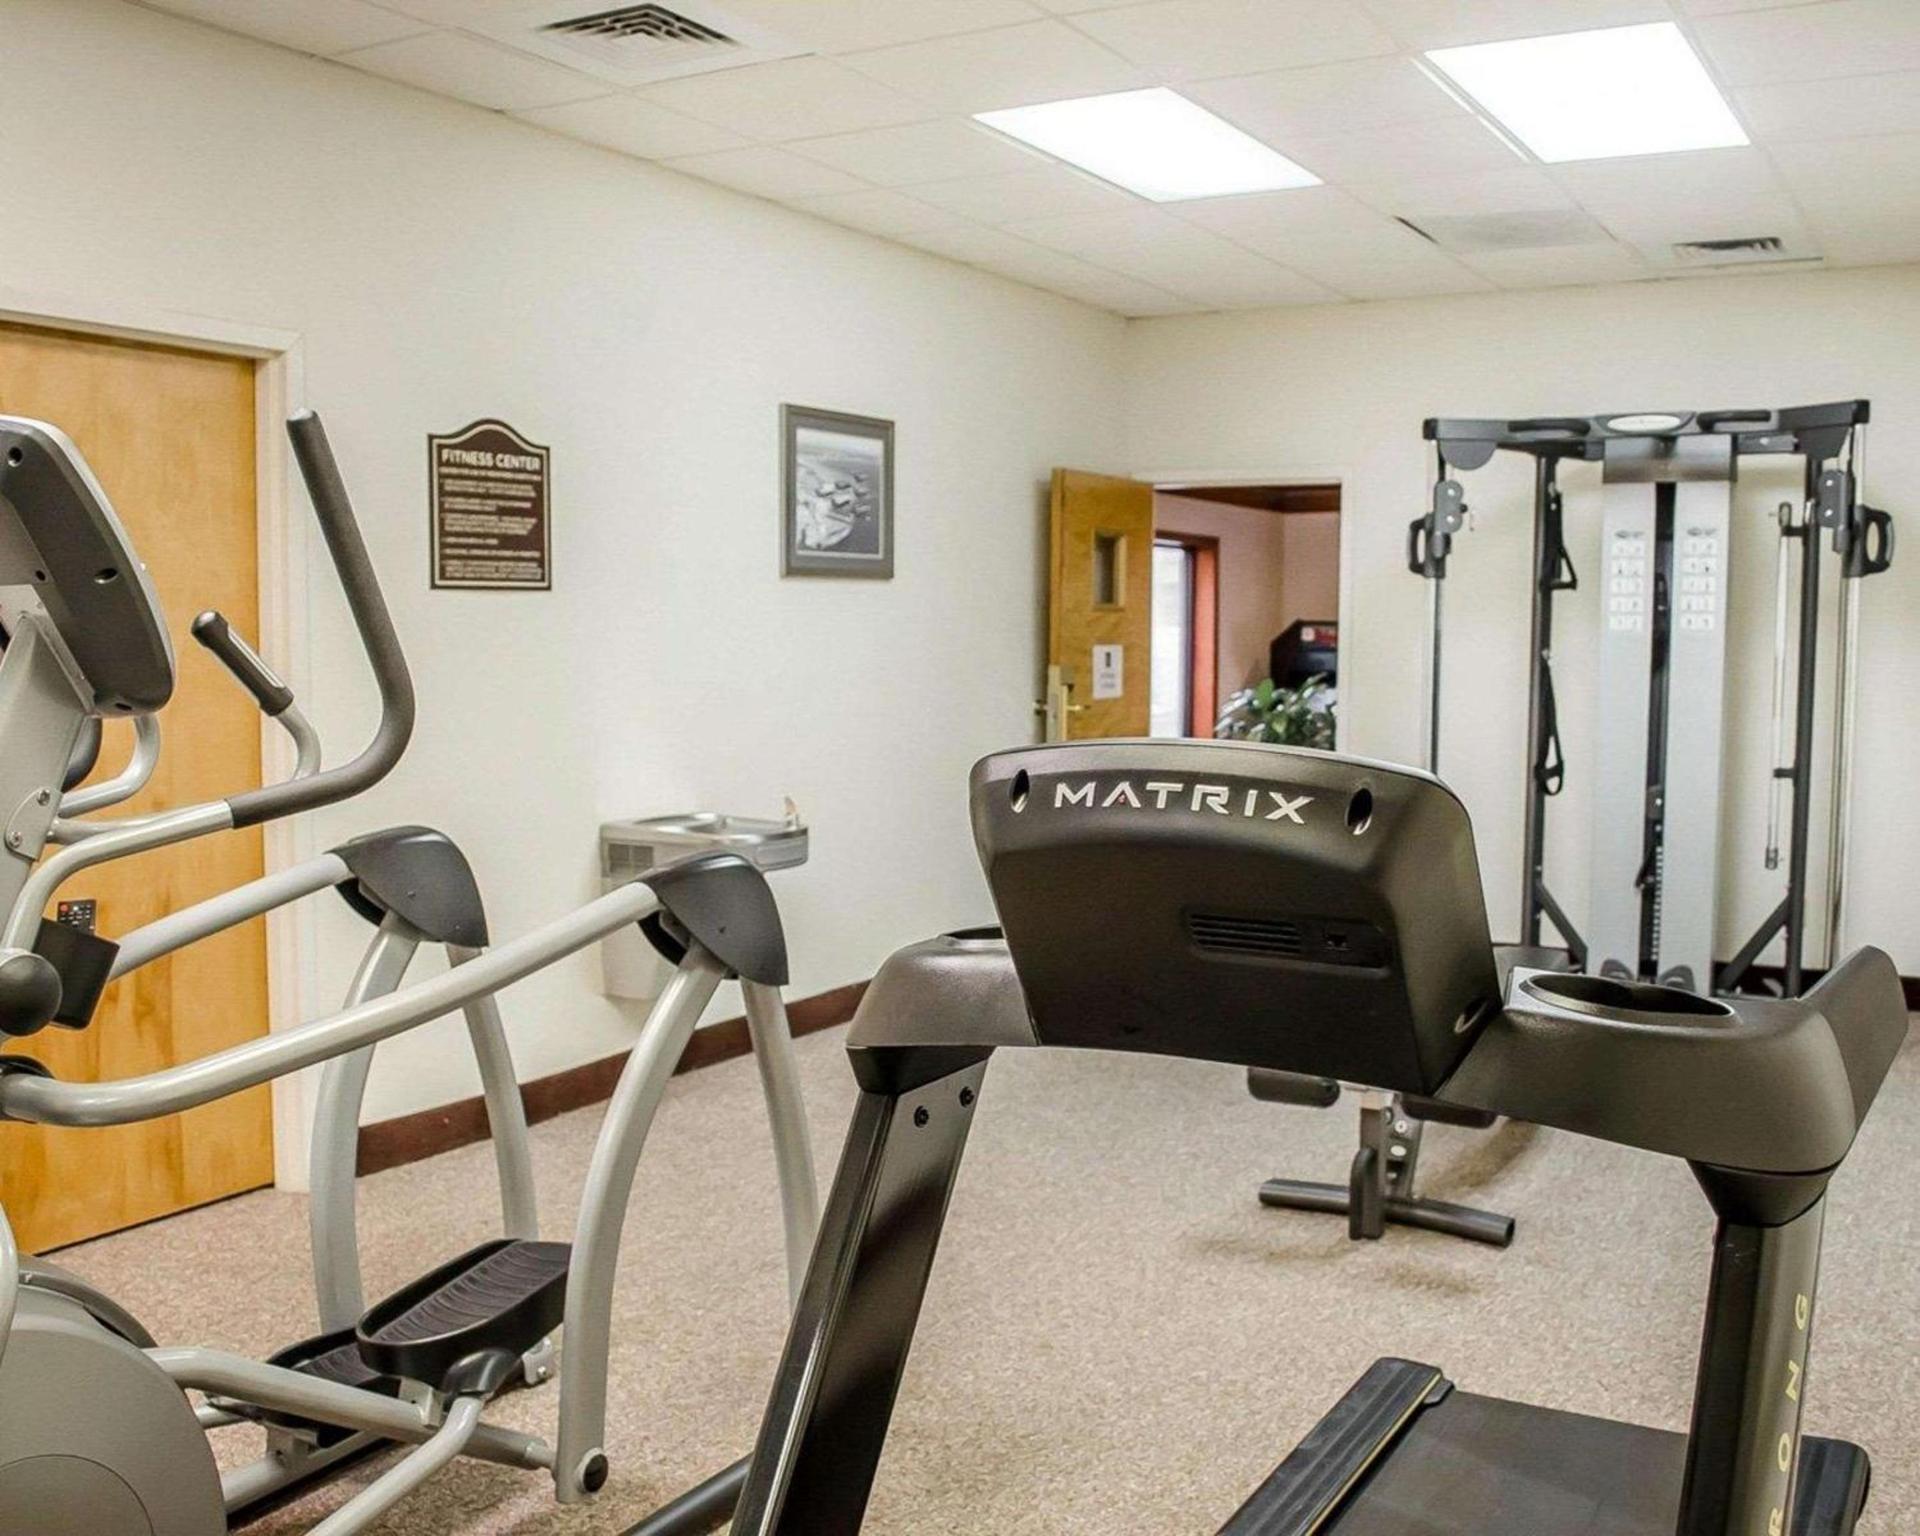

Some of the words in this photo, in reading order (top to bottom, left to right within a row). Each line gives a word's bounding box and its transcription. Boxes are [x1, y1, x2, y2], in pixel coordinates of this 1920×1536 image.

[441, 448, 494, 468] FITNESS
[495, 453, 541, 471] CENTER
[1054, 781, 1315, 825] MATRIX
